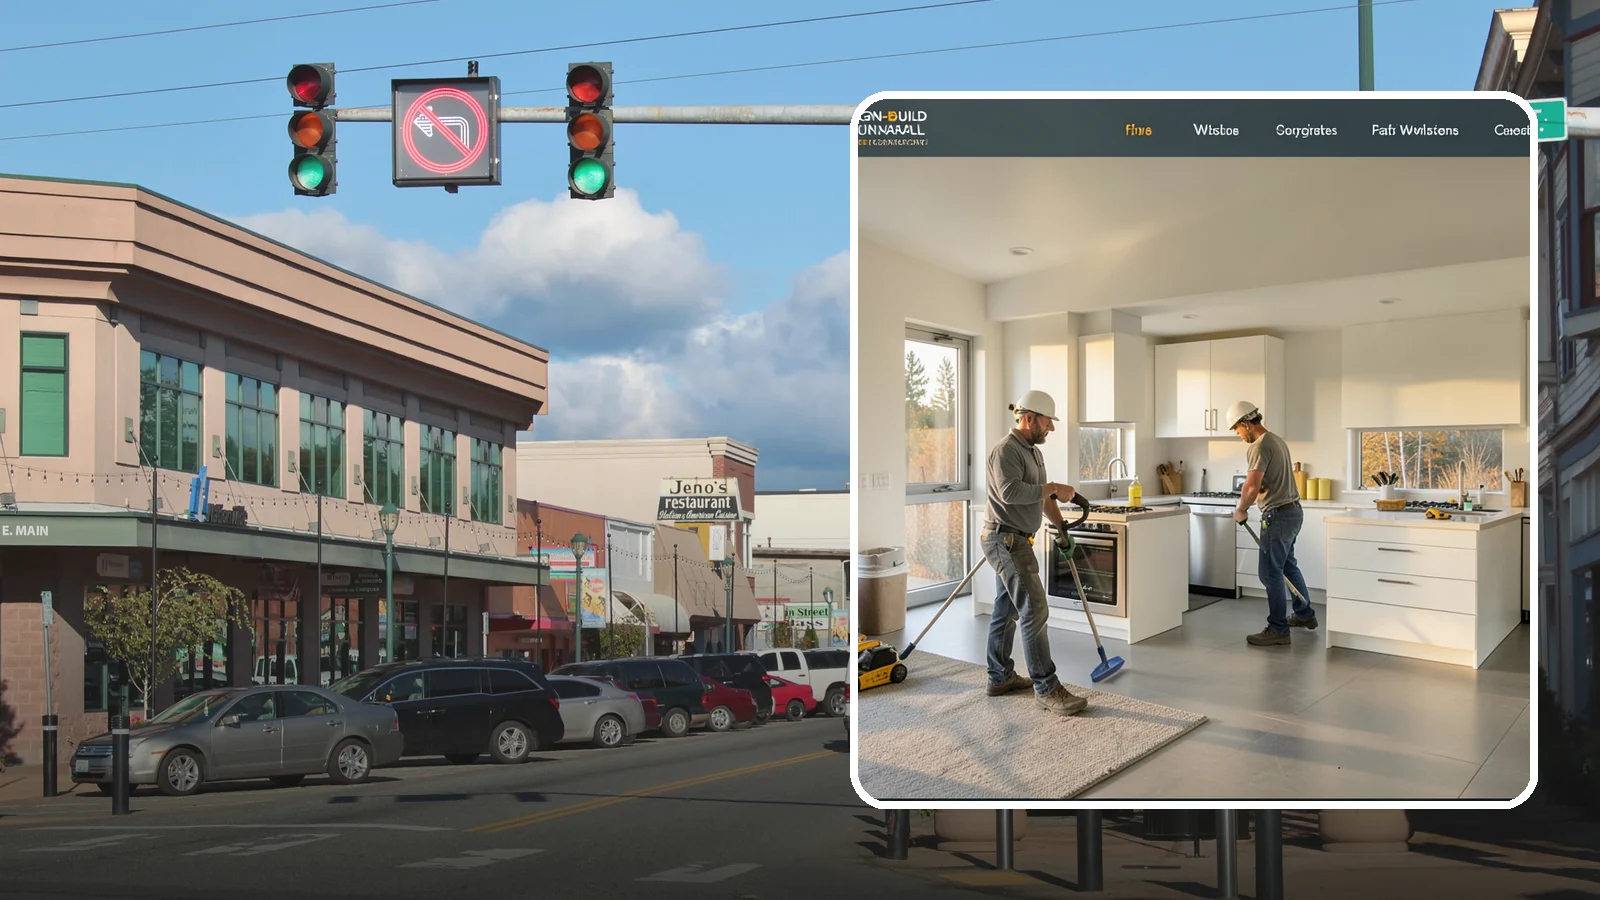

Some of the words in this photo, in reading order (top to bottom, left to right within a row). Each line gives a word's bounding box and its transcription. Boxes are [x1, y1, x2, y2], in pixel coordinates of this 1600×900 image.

[669, 479, 728, 495] Jeno's
[665, 496, 731, 509] restaurant
[686, 509, 715, 520] American
[714, 509, 738, 520] Cuisine
[2, 525, 13, 536] E.
[15, 525, 49, 537] MAIN
[797, 607, 828, 617] Street
